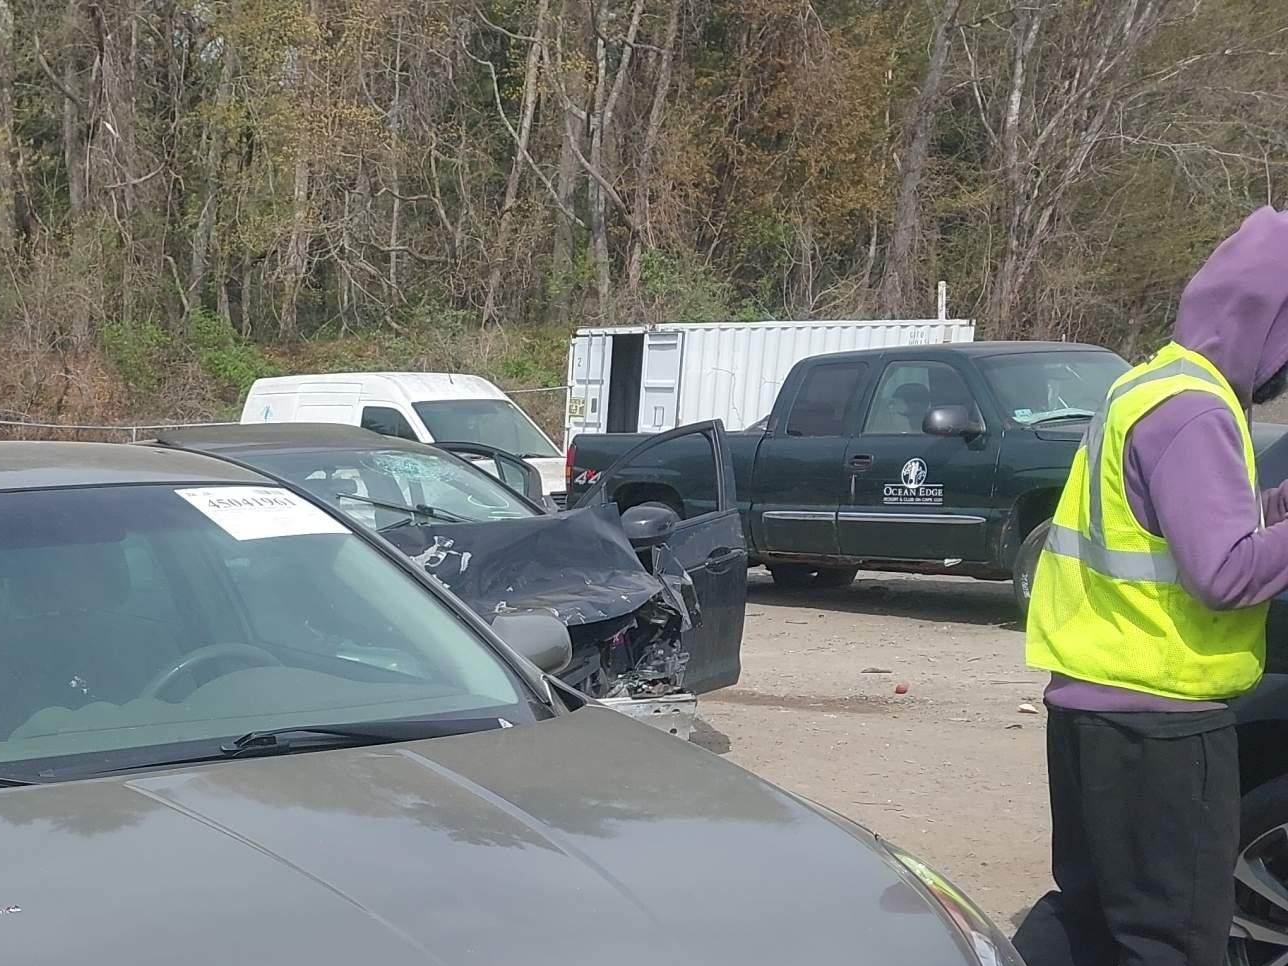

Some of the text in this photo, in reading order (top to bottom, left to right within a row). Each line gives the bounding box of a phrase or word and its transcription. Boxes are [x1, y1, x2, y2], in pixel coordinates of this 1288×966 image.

[883, 486, 944, 496] OCEAN EDGE
[207, 497, 297, 509] 45041961
